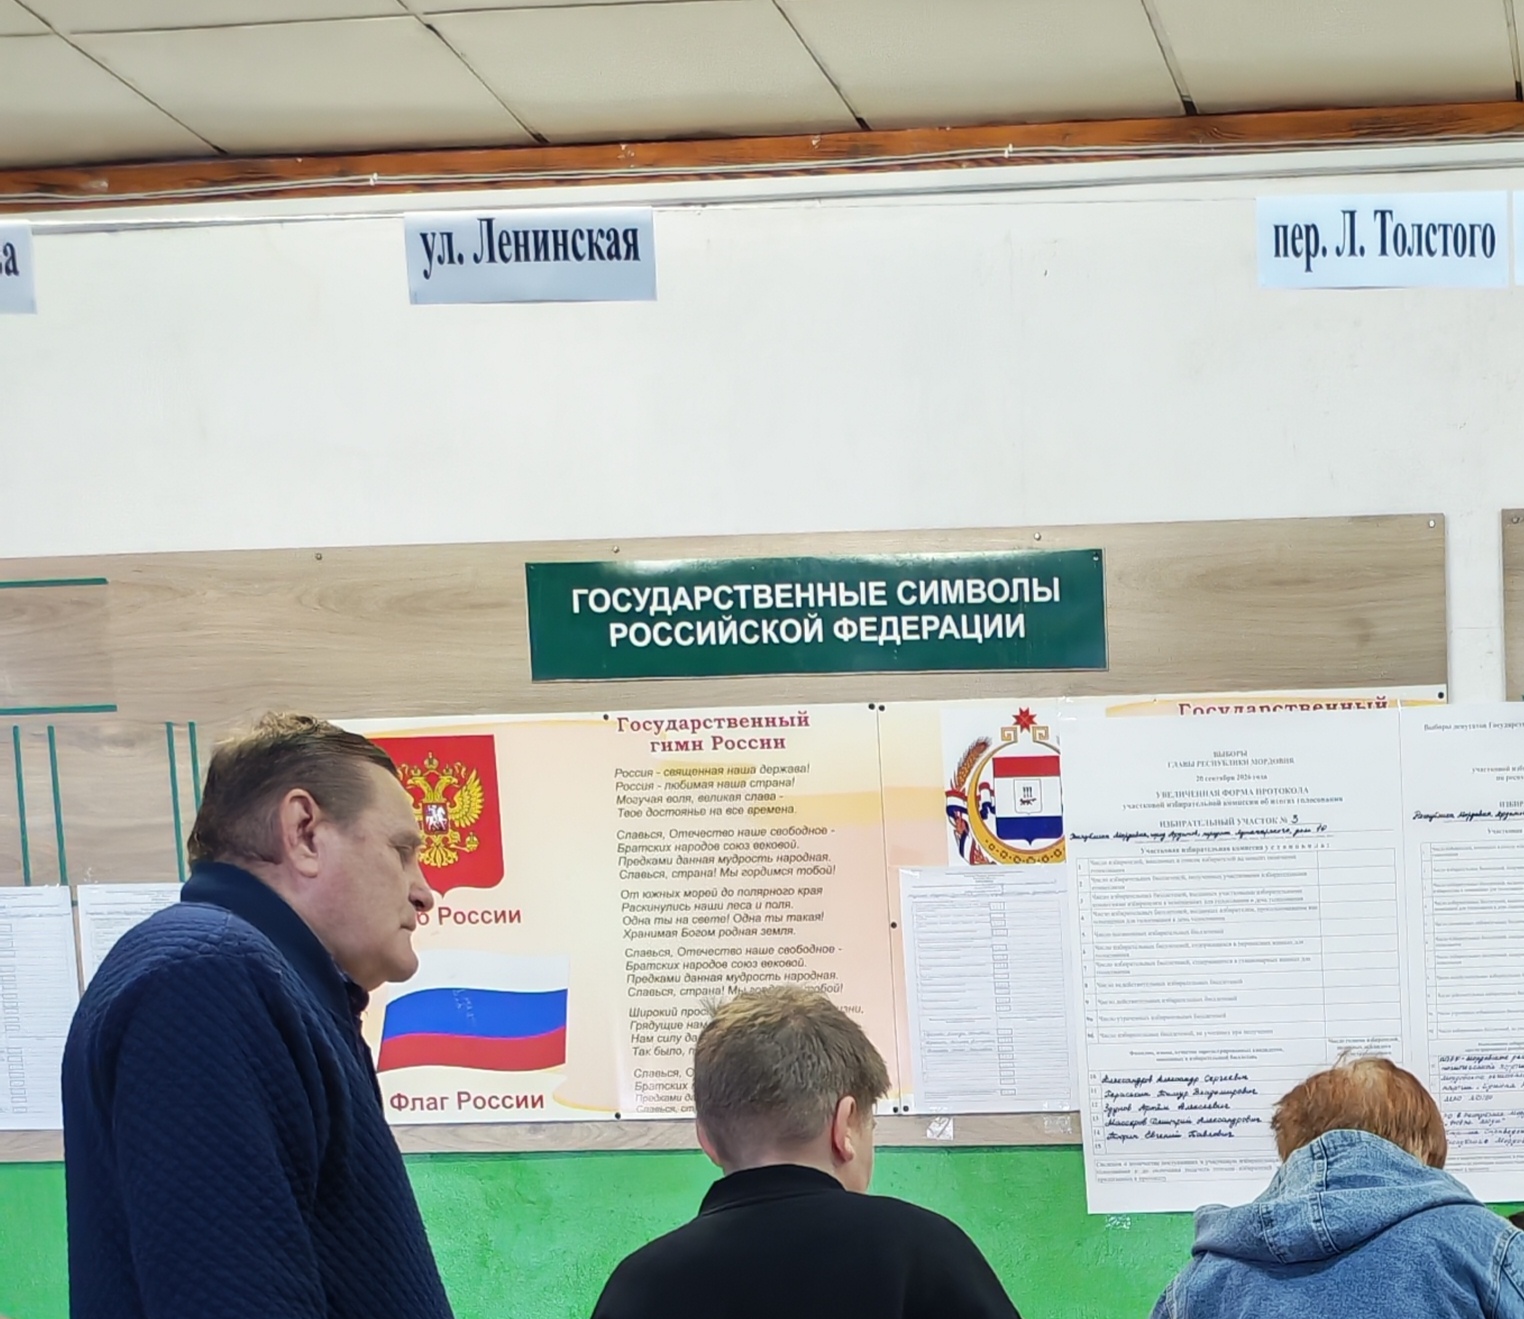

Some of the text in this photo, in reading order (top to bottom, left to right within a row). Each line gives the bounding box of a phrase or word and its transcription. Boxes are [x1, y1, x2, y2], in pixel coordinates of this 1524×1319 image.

[419, 217, 640, 279] ул. Ленинская
[1273, 209, 1495, 272] пер. Л. Толстого
[572, 577, 1059, 615] ГОСУДАРСТВЕННЫЕ СИМВОЛЫ
[609, 613, 1024, 646] РОССИЙСКОЙ ФЕДЕРАЦИИ
[617, 711, 810, 735] Государственный
[650, 736, 786, 753] гимн России
[614, 763, 809, 778] Россия священная наша держава!
[615, 776, 795, 791] Россия любимая наша страна!
[616, 792, 776, 806] Могучая воля, великая слава
[617, 805, 796, 817] Твое достоянье на все времена.
[616, 825, 827, 840] Славься, Отечество наше свободное
[616, 838, 799, 854] Братских народов союз вековой.
[618, 851, 830, 868] Предками данная мудрость народная.
[619, 864, 835, 880] Славься, страна! Мы гордимся тобой!
[620, 886, 823, 900] От южных морей до полярного края
[621, 900, 793, 913] Раскинулись наши леса и поля.
[438, 906, 522, 925] России
[622, 910, 824, 925] Одна ты на свете! Одна ты такая!
[623, 925, 795, 940] Хранимая Богом родная земля.
[624, 943, 835, 957] Славься, Отечество наше свободное
[625, 957, 806, 972] Братских народов союз вековой.
[626, 969, 837, 985] Предками данная мудрость народная.
[627, 986, 675, 997] Славься,
[679, 985, 724, 998] страна!
[390, 1091, 544, 1111] Флаг России
